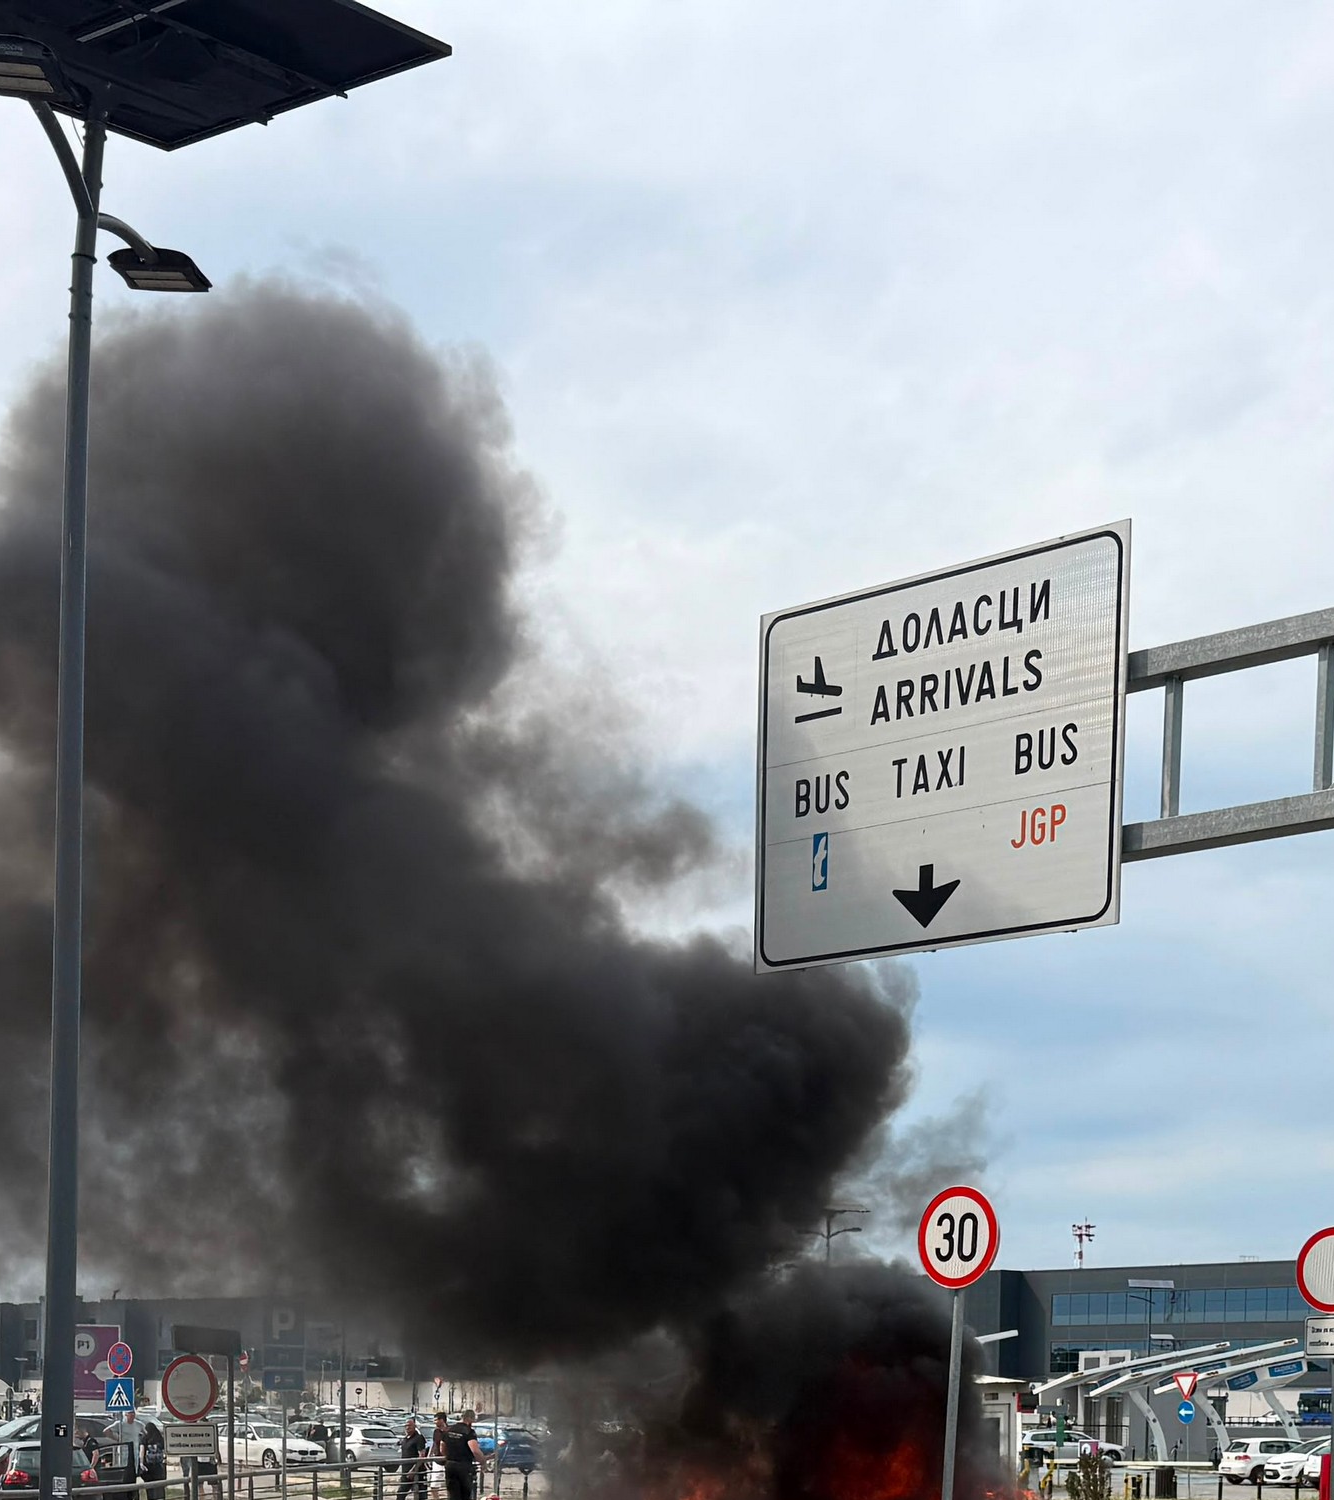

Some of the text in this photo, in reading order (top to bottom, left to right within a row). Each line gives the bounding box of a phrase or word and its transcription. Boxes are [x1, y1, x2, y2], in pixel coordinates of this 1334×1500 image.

[872, 579, 1051, 661] ДОЛАСЦИ
[871, 649, 1042, 726] ARRIVALS
[795, 723, 1078, 818] BUS TAXI BUS
[1009, 803, 1067, 849] JGP
[935, 1212, 978, 1262] 30
